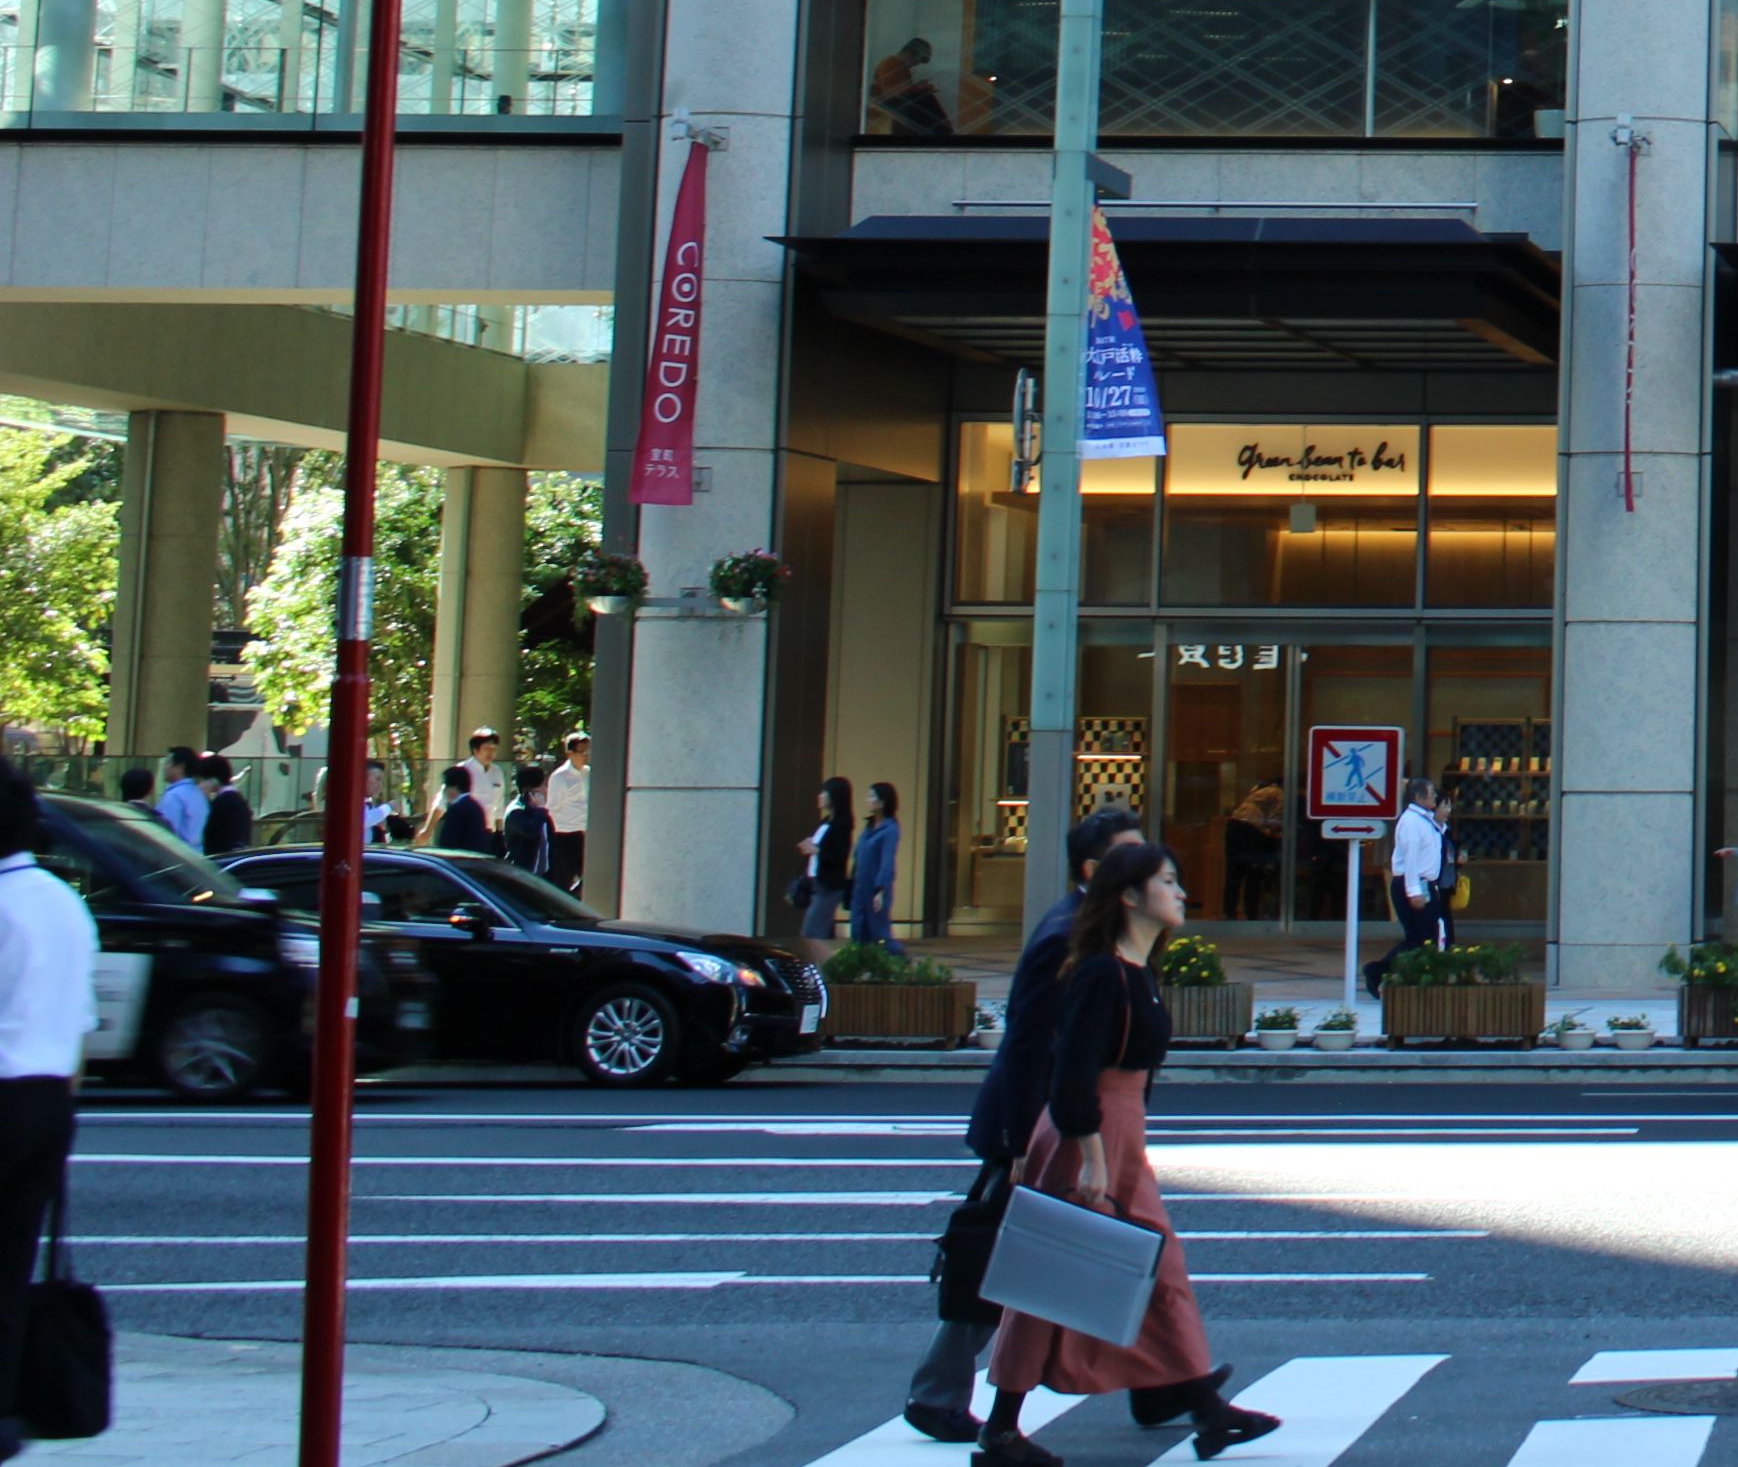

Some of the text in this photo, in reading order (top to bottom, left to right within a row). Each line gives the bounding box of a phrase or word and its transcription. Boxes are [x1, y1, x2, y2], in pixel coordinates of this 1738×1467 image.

[655, 241, 698, 423] COREDO
[1346, 446, 1367, 470] to
[1370, 441, 1406, 474] bar
[643, 463, 681, 479] テラス
[1288, 473, 1355, 482] CHOCOLATE
